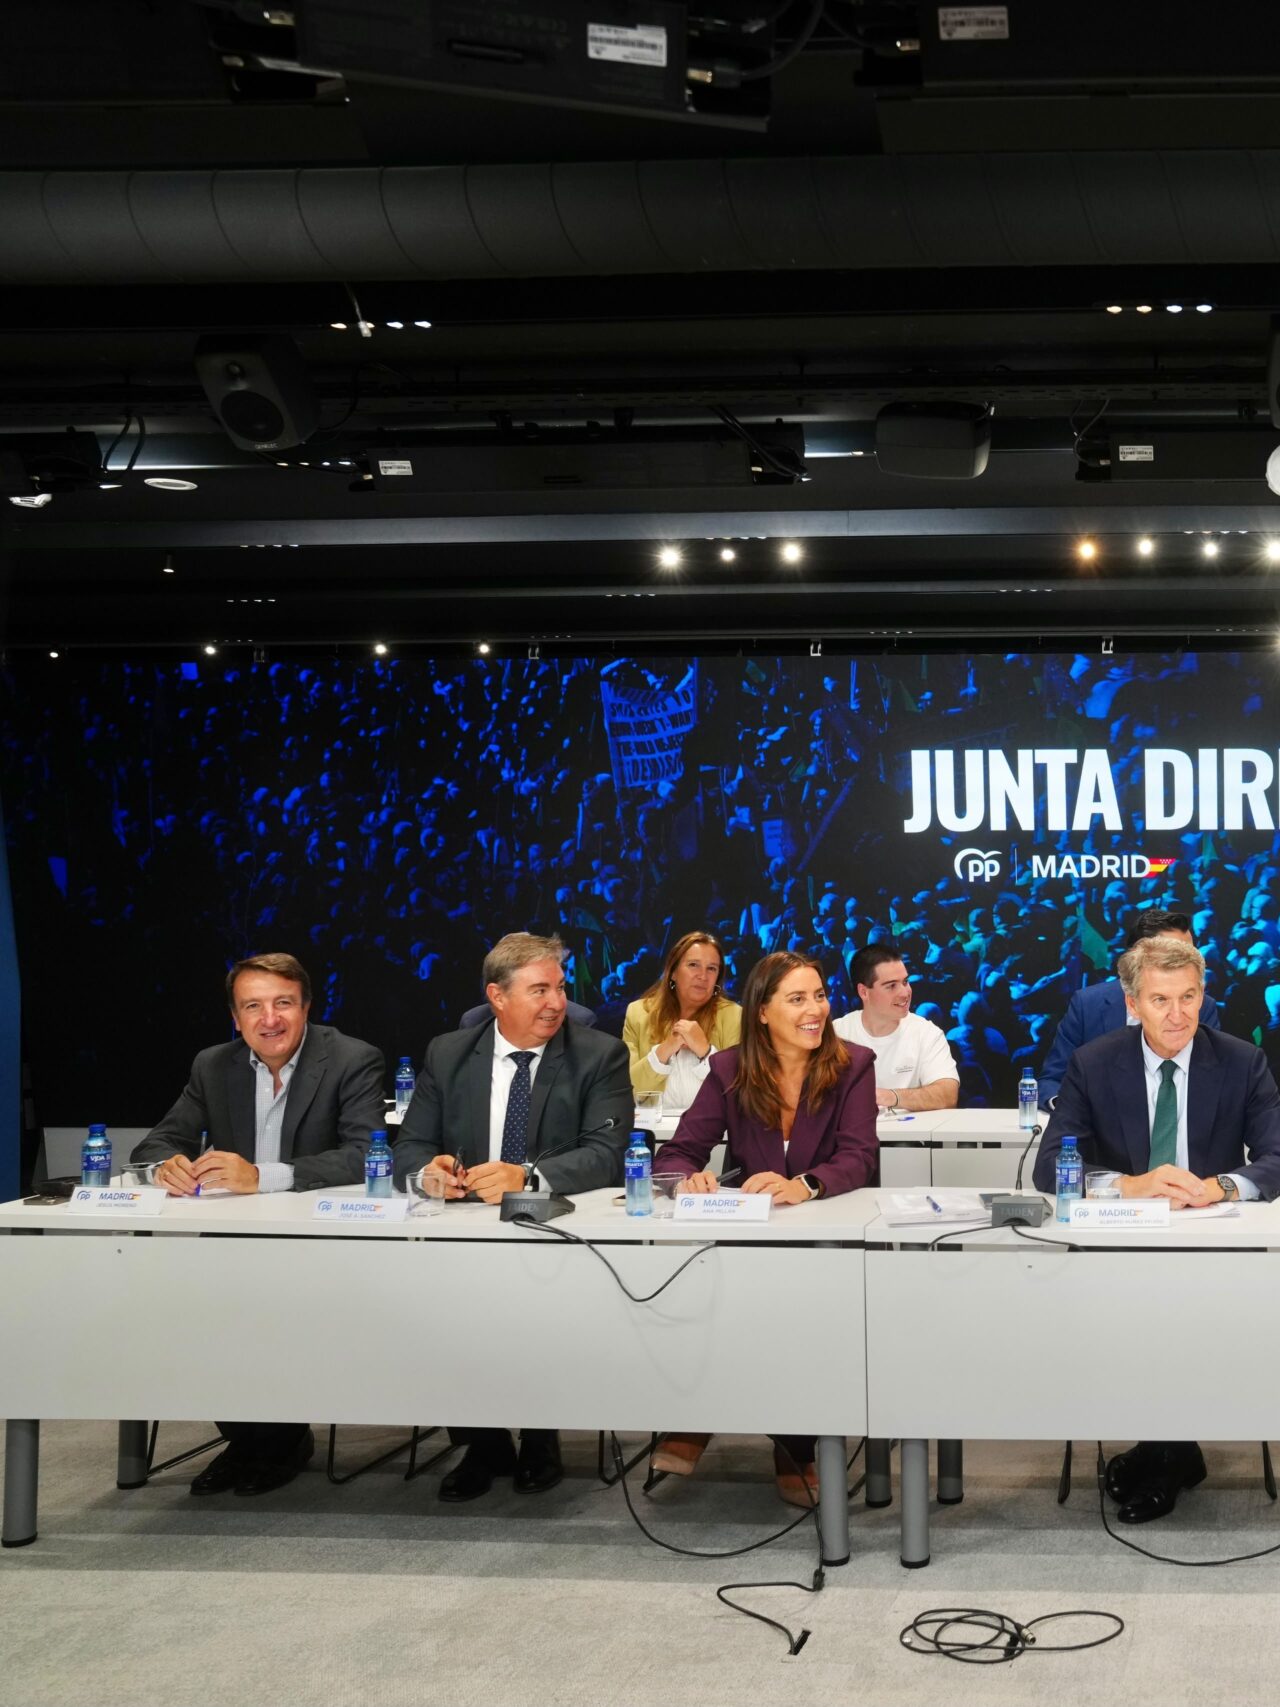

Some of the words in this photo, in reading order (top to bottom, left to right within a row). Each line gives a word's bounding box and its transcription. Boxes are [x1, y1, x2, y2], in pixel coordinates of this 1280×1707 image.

[904, 748, 1122, 833] JUNTA
[1032, 855, 1151, 878] MADRID
[98, 1192, 135, 1200] MADRID
[340, 1203, 376, 1211] MADRID
[703, 1199, 739, 1207] MADRID
[1098, 1209, 1136, 1217] MADRID
